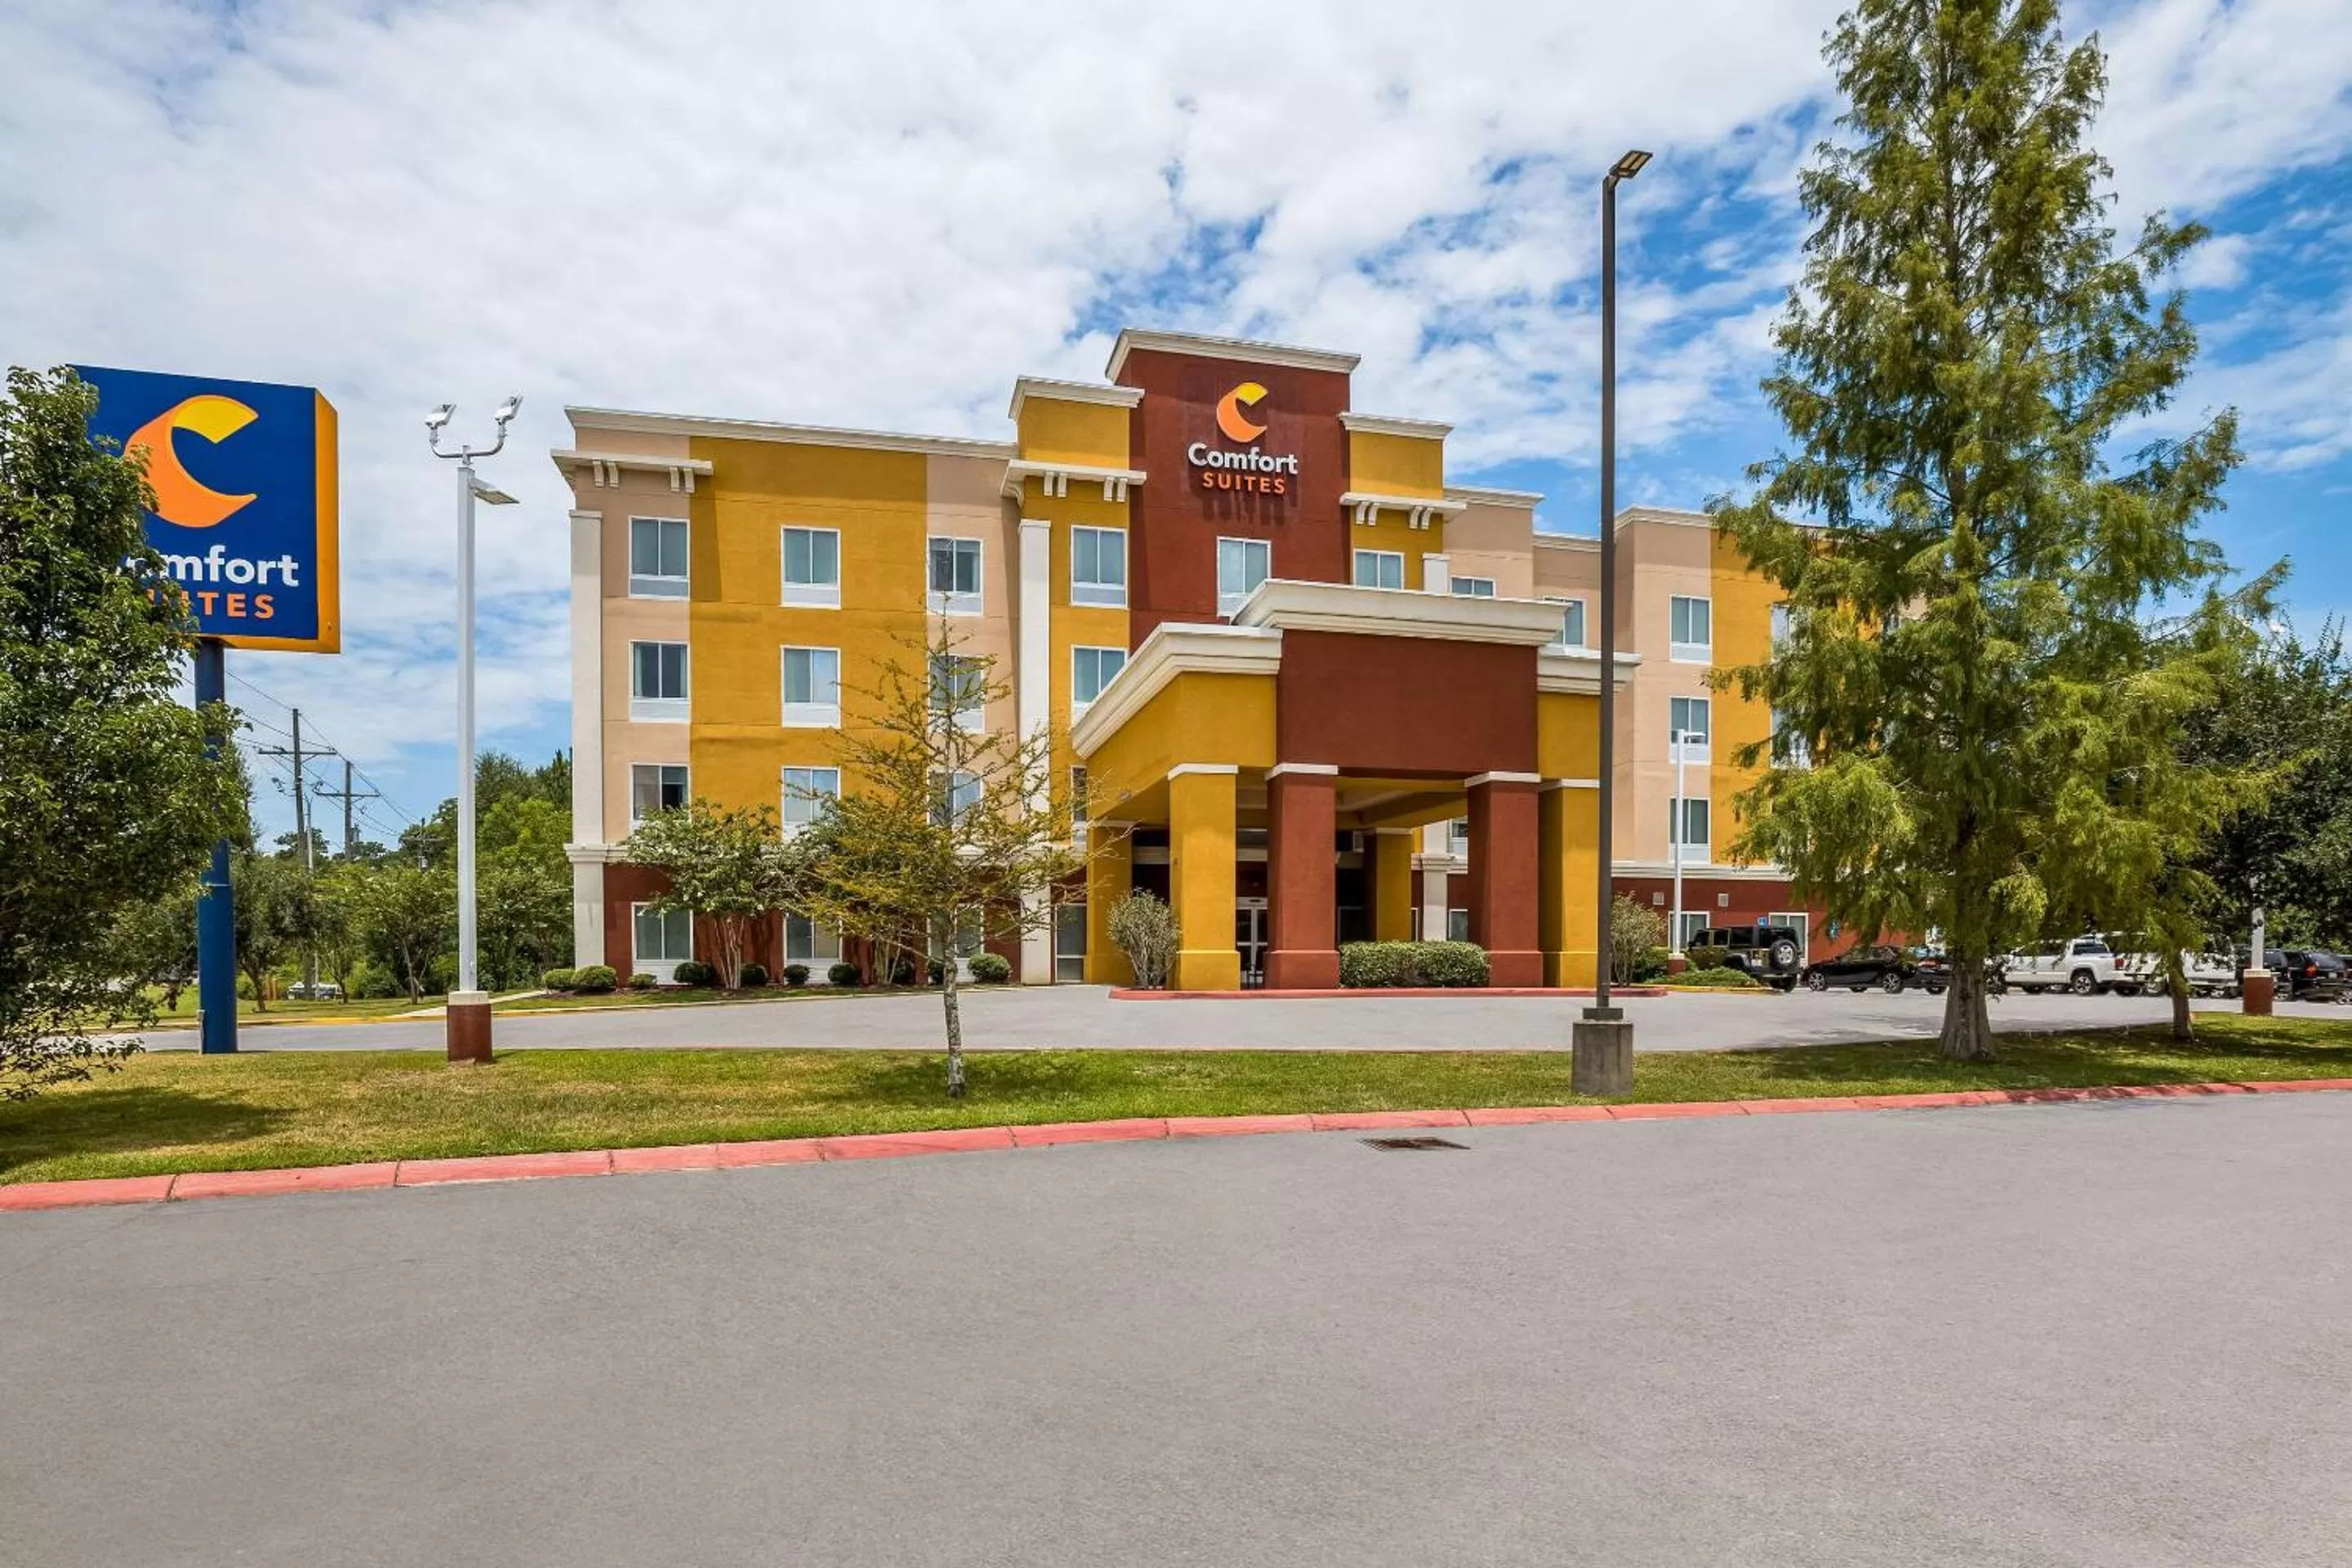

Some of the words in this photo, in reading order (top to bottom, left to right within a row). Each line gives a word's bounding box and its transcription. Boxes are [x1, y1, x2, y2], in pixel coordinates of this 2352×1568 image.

[1188, 442, 1298, 474] Comfort
[1202, 472, 1285, 495] SUITES
[116, 545, 299, 587] omfort
